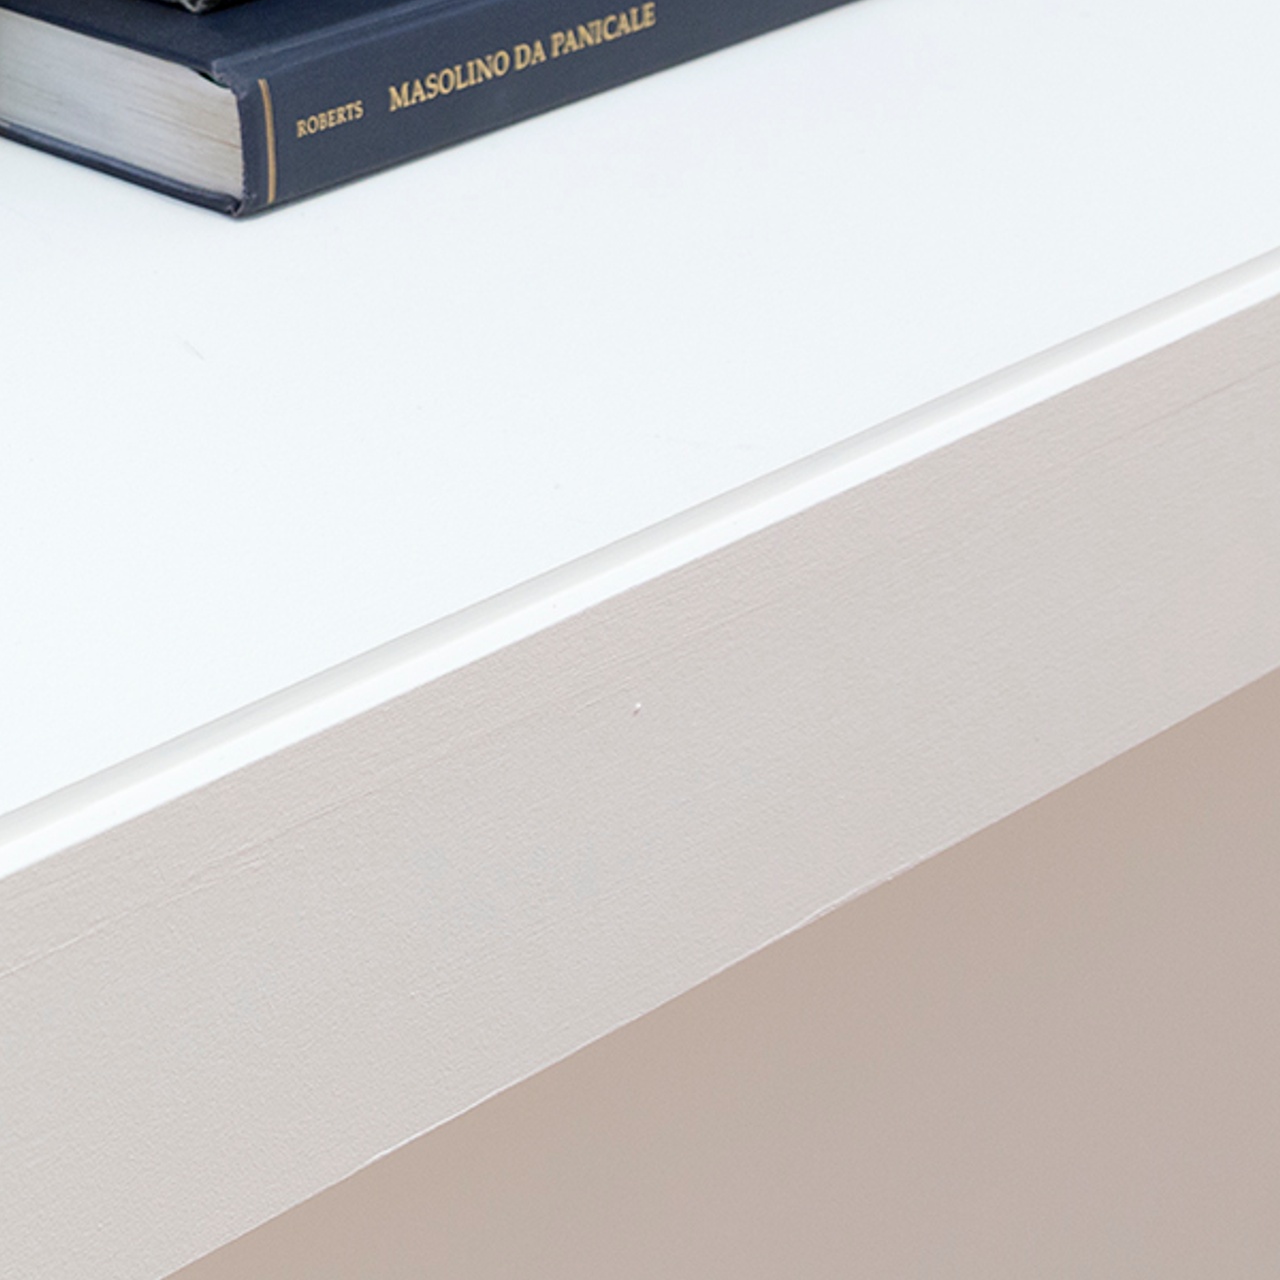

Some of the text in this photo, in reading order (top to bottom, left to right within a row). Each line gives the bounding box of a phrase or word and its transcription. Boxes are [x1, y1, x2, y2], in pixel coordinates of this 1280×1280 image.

[387, 1, 657, 112] MASOLINO DA PANICALE
[295, 99, 365, 138] ROBERTS
